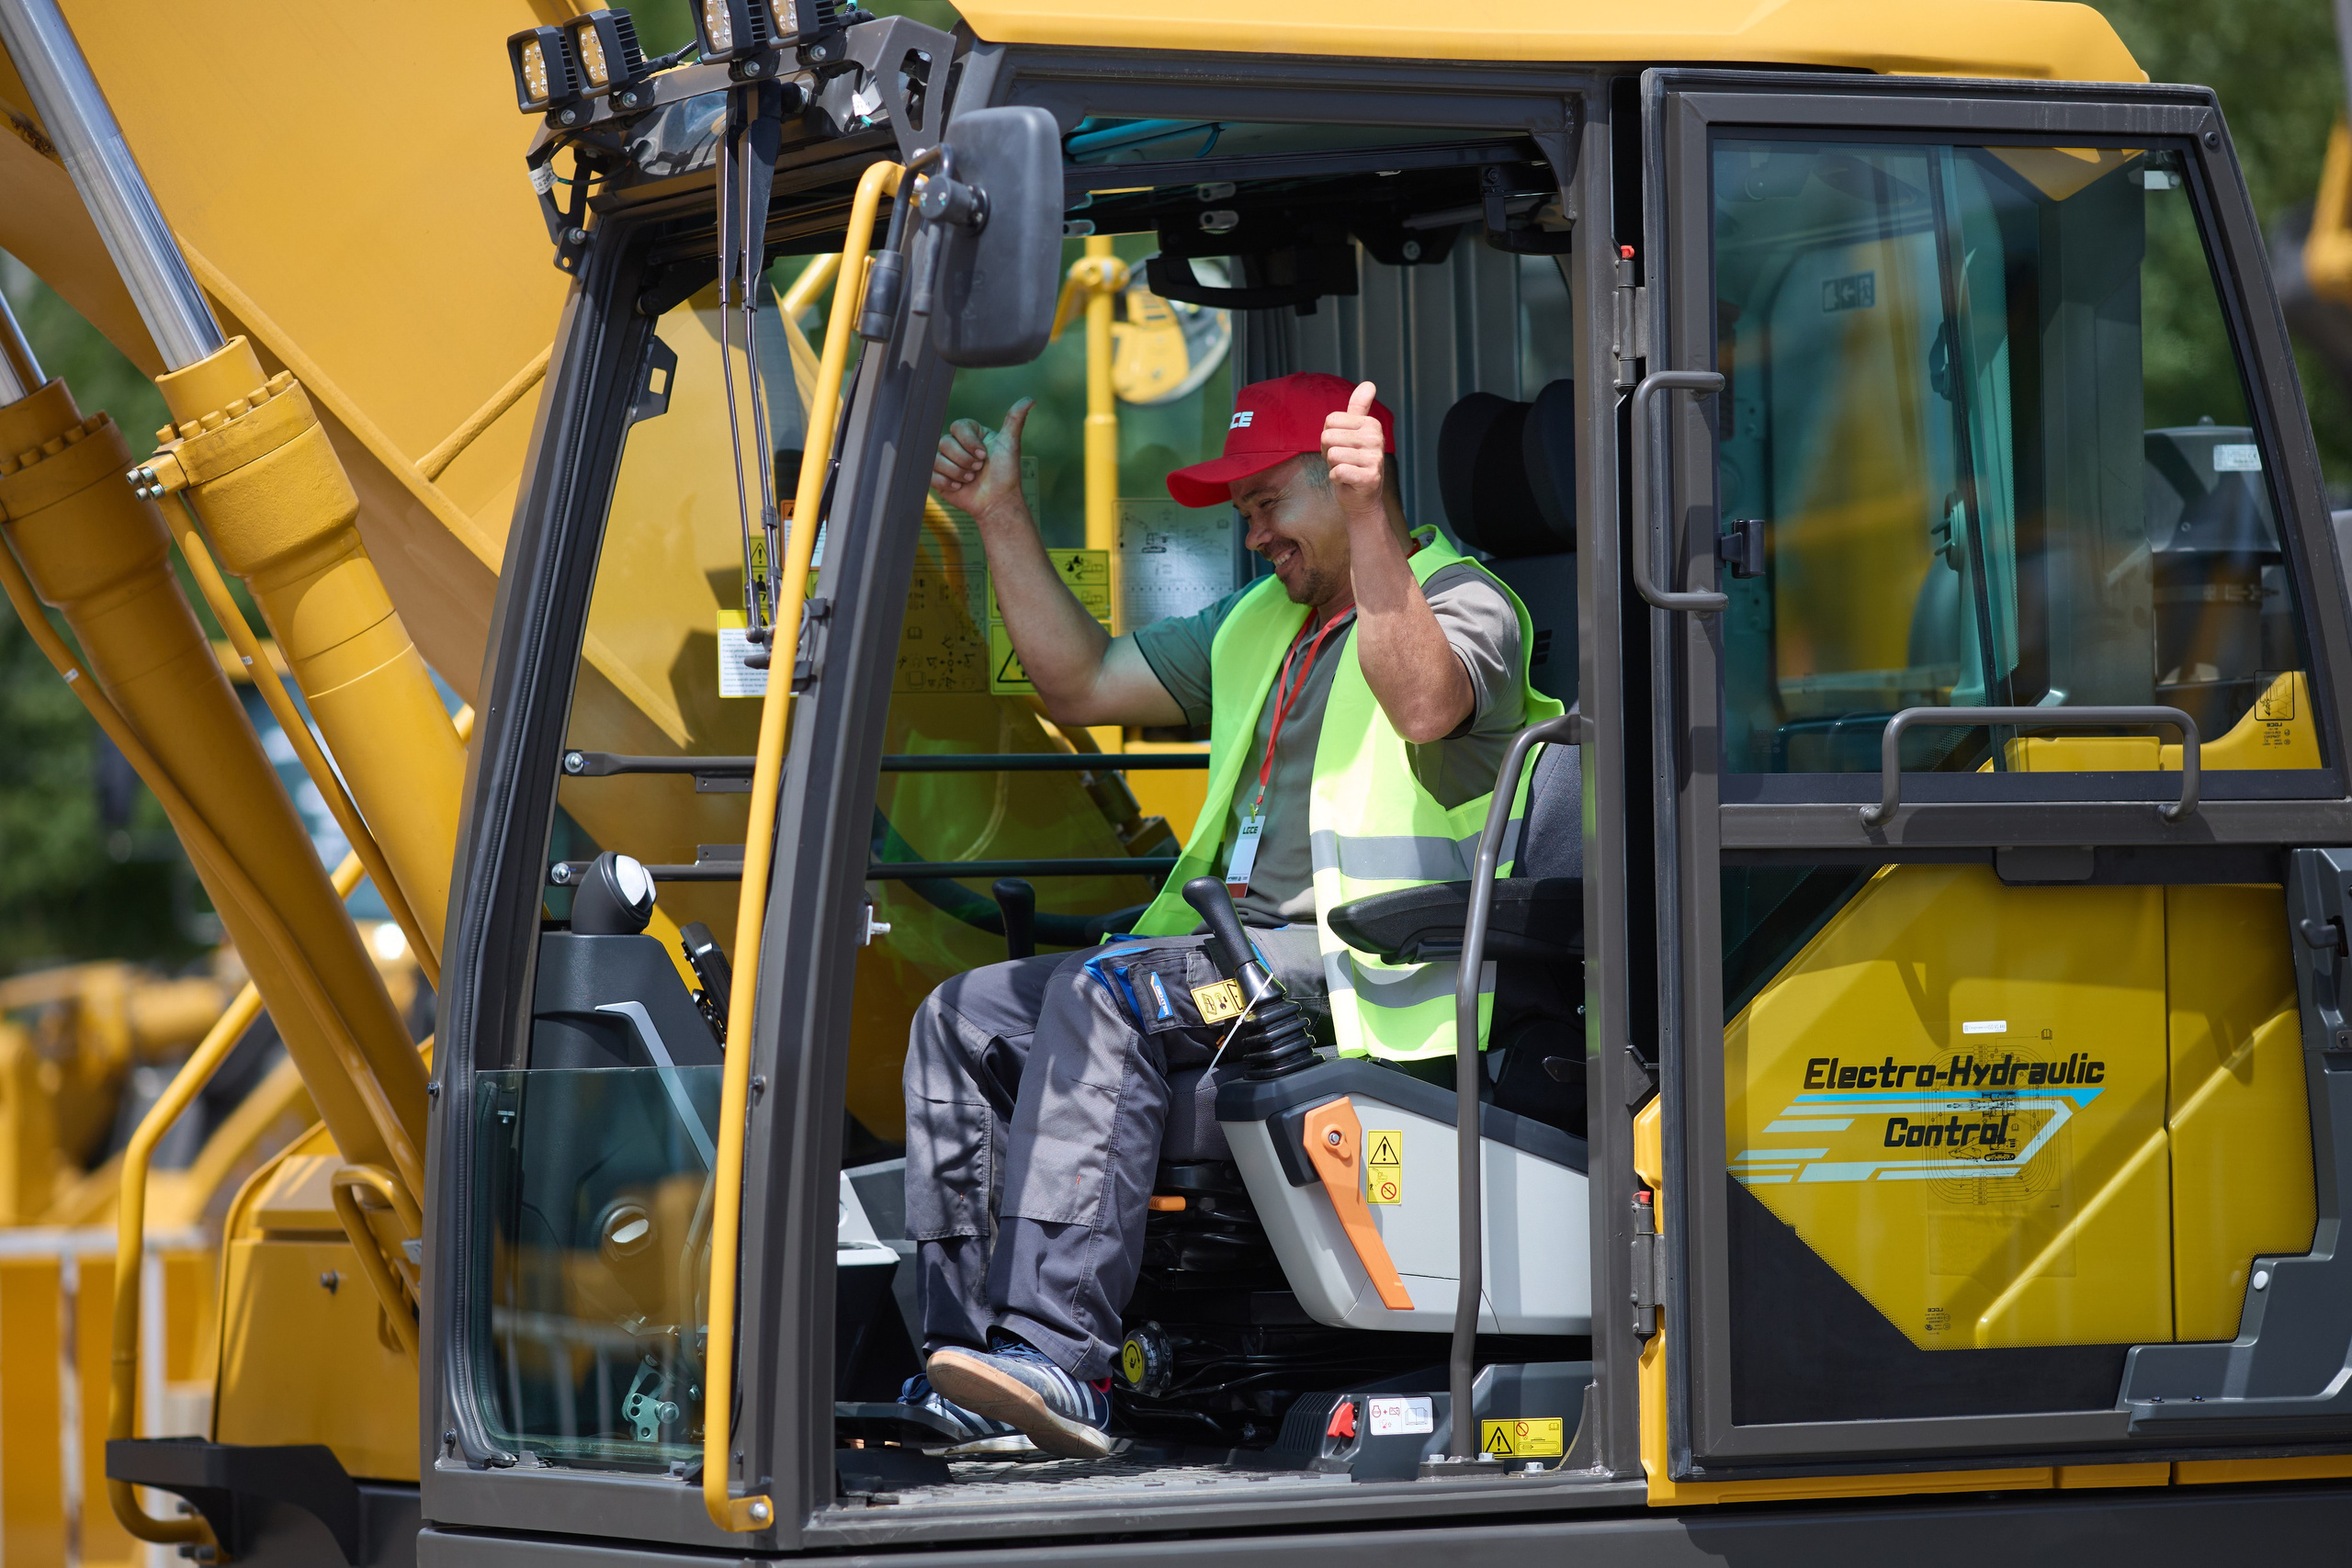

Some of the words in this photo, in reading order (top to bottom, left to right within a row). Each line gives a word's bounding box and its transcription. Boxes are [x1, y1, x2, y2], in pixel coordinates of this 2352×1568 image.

[1242, 826, 1258, 835] LGCE
[1803, 1053, 2105, 1089] Electro-Hydraulic
[1883, 1115, 2009, 1147] Control
